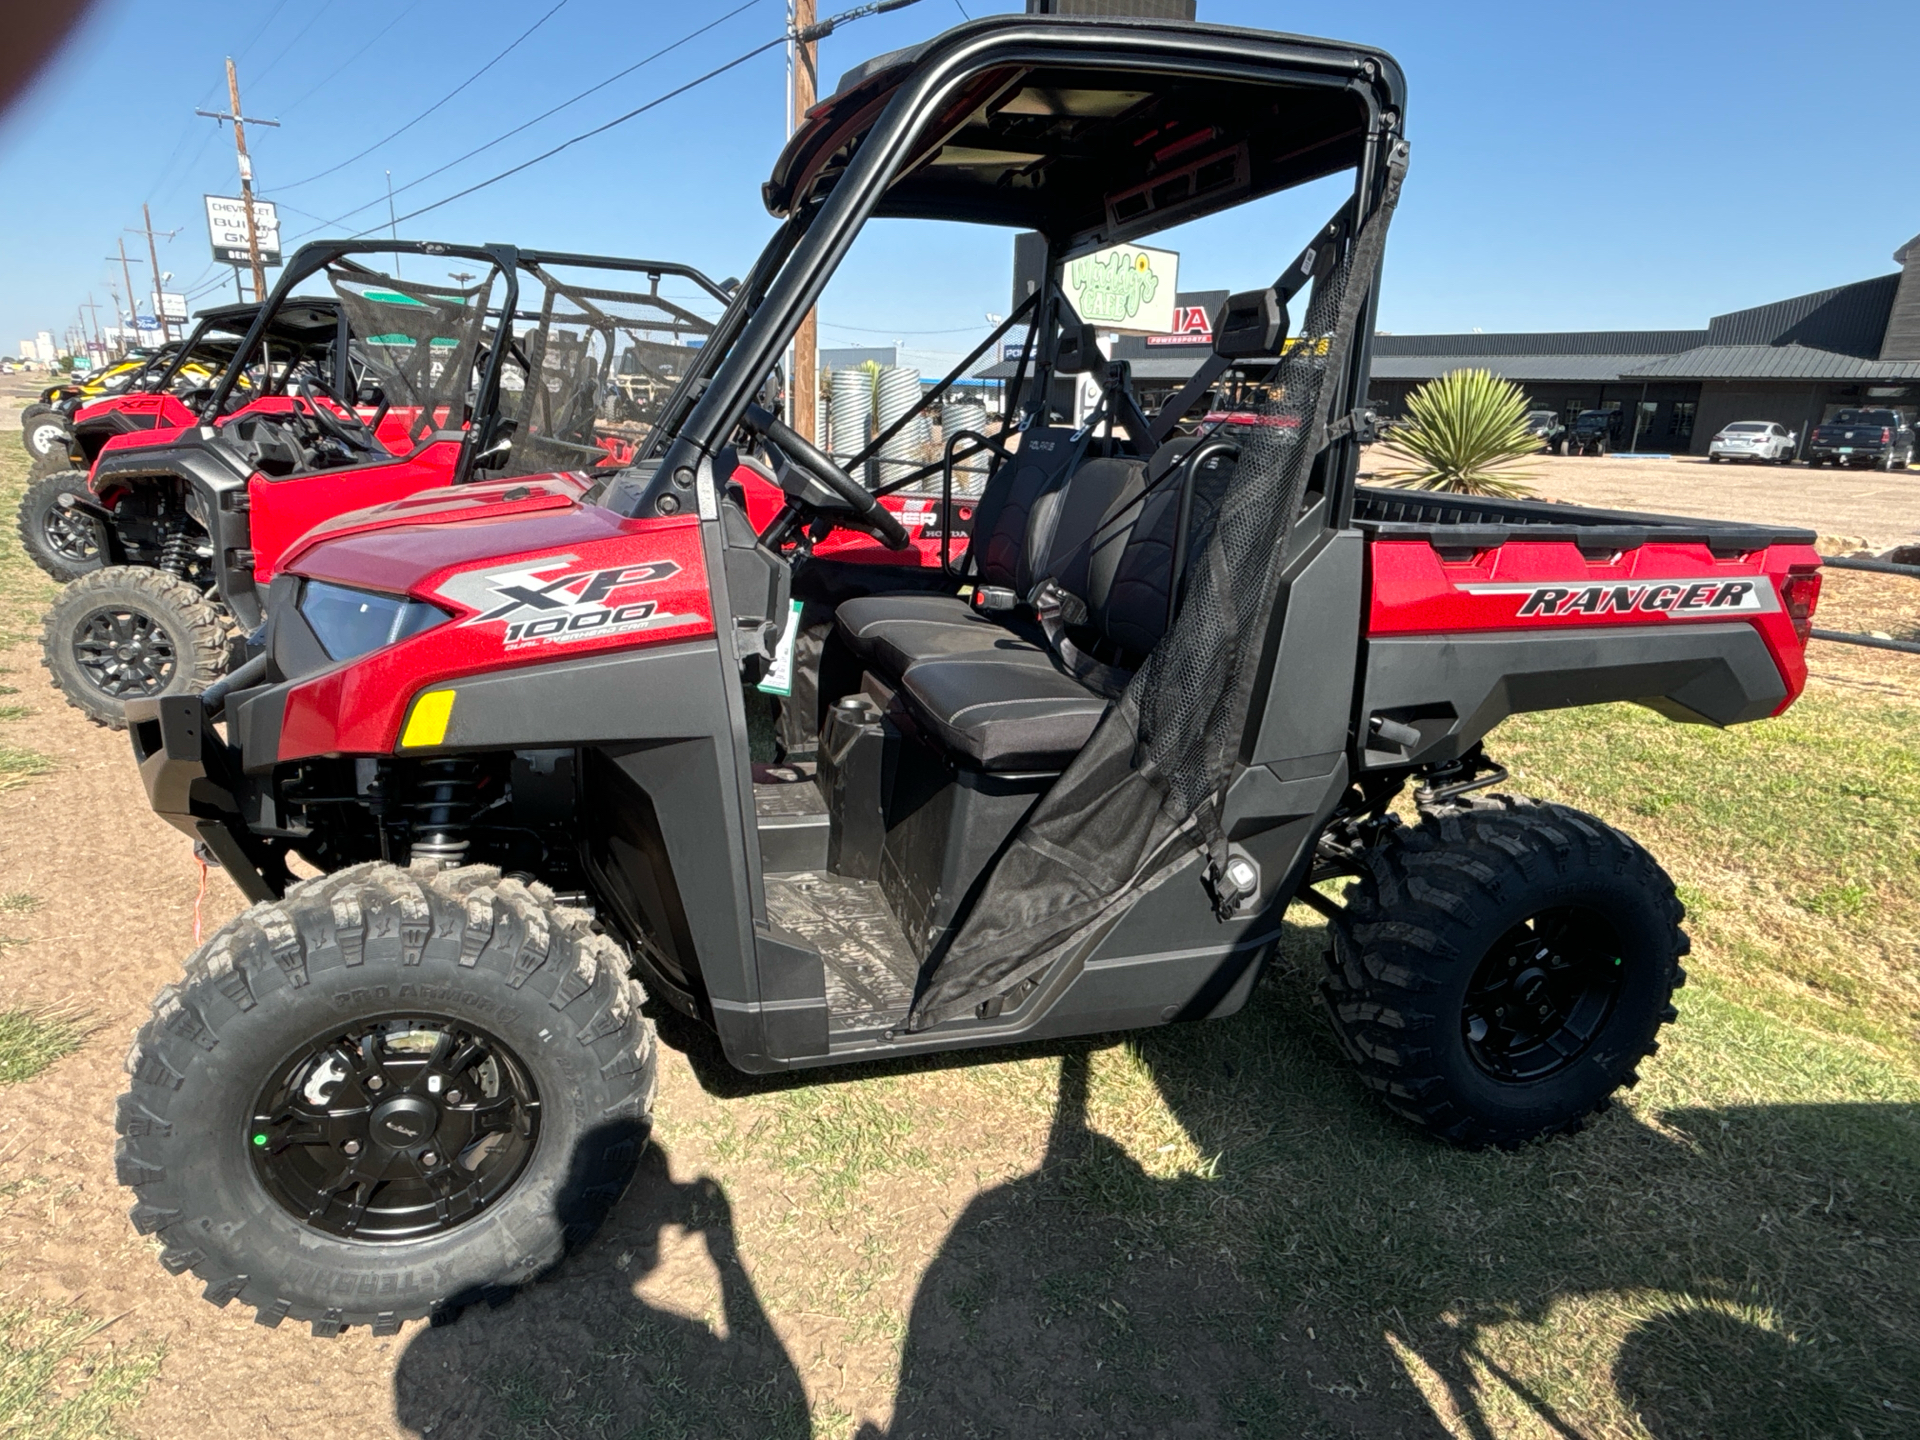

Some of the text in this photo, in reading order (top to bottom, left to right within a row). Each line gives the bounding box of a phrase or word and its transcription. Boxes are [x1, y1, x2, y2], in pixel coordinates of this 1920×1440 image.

[212, 203, 270, 216] CHEVRLET
[227, 250, 268, 262] BENR
[1149, 336, 1208, 344] POWERSPORTS
[458, 560, 683, 627] XP
[1516, 581, 1754, 617] RANGER
[504, 601, 658, 643] 1000
[504, 621, 650, 651] DUAL OVERHEAD CAM
